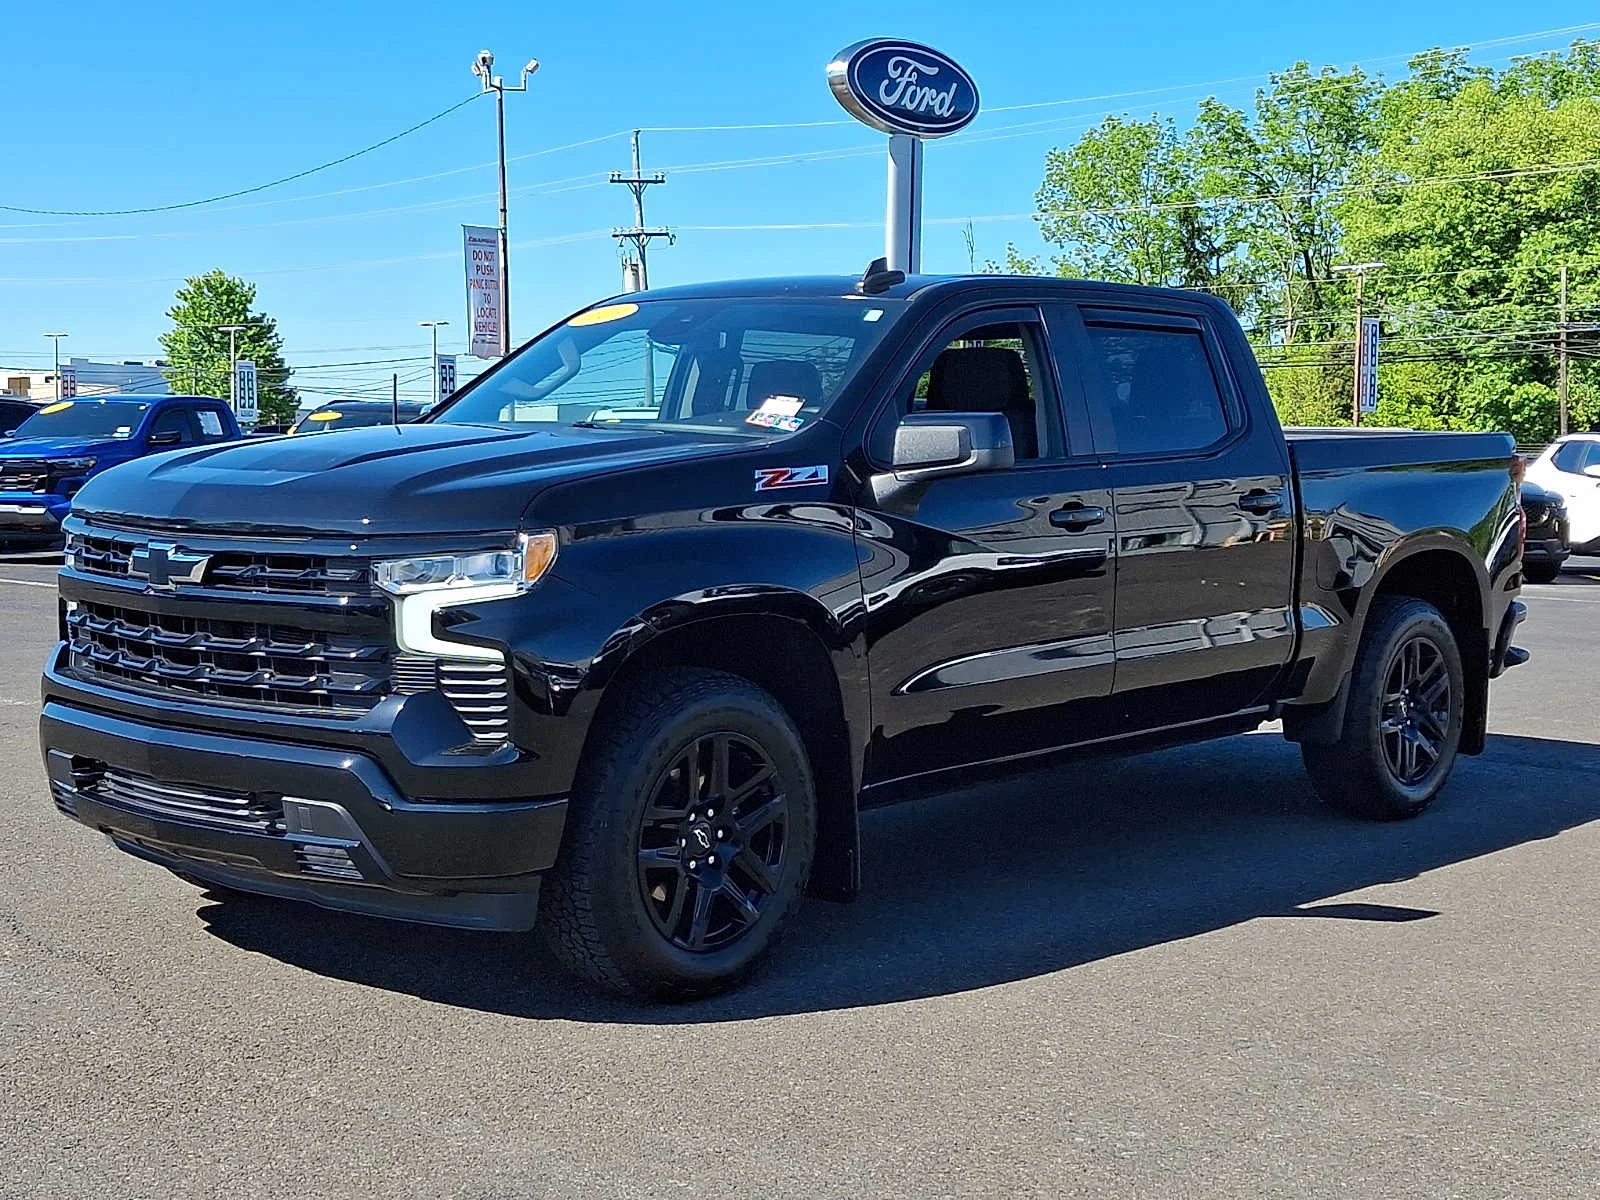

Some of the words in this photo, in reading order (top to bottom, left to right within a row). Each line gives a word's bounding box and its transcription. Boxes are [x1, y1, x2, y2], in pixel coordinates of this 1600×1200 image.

[879, 56, 958, 118] Ford
[472, 249, 483, 261] DO
[475, 264, 495, 276] PUSH
[483, 292, 492, 304] TO
[755, 465, 828, 492] Z71
